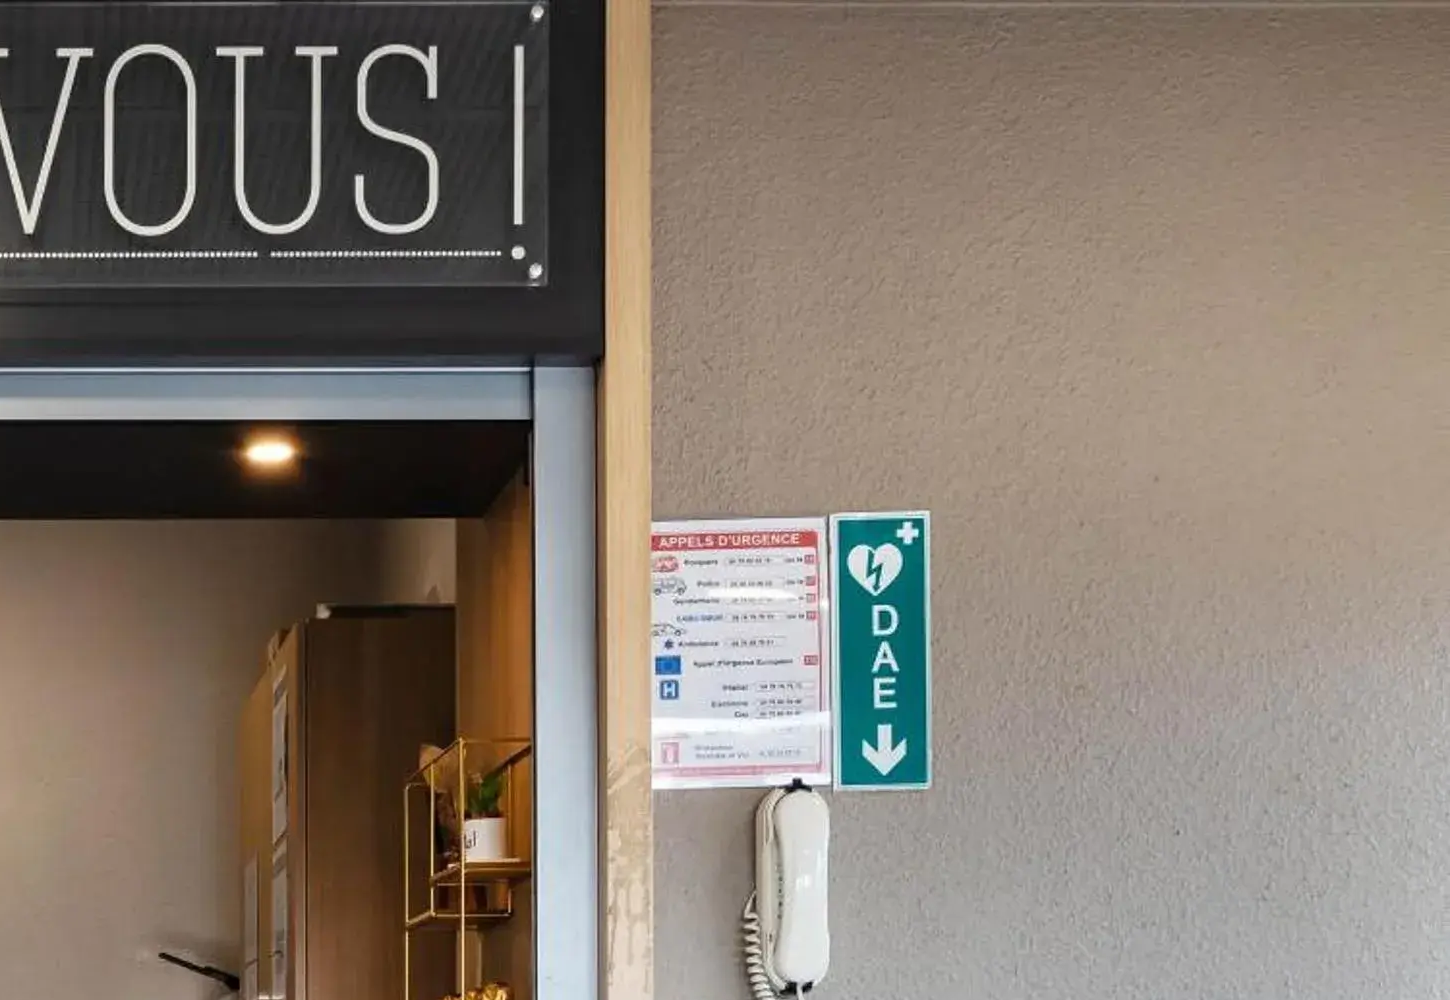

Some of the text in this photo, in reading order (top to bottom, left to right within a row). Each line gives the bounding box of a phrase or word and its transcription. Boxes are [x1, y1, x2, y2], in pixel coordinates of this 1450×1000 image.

[659, 533, 800, 548] APPELS D'URGENCE
[871, 605, 900, 709] DAE
